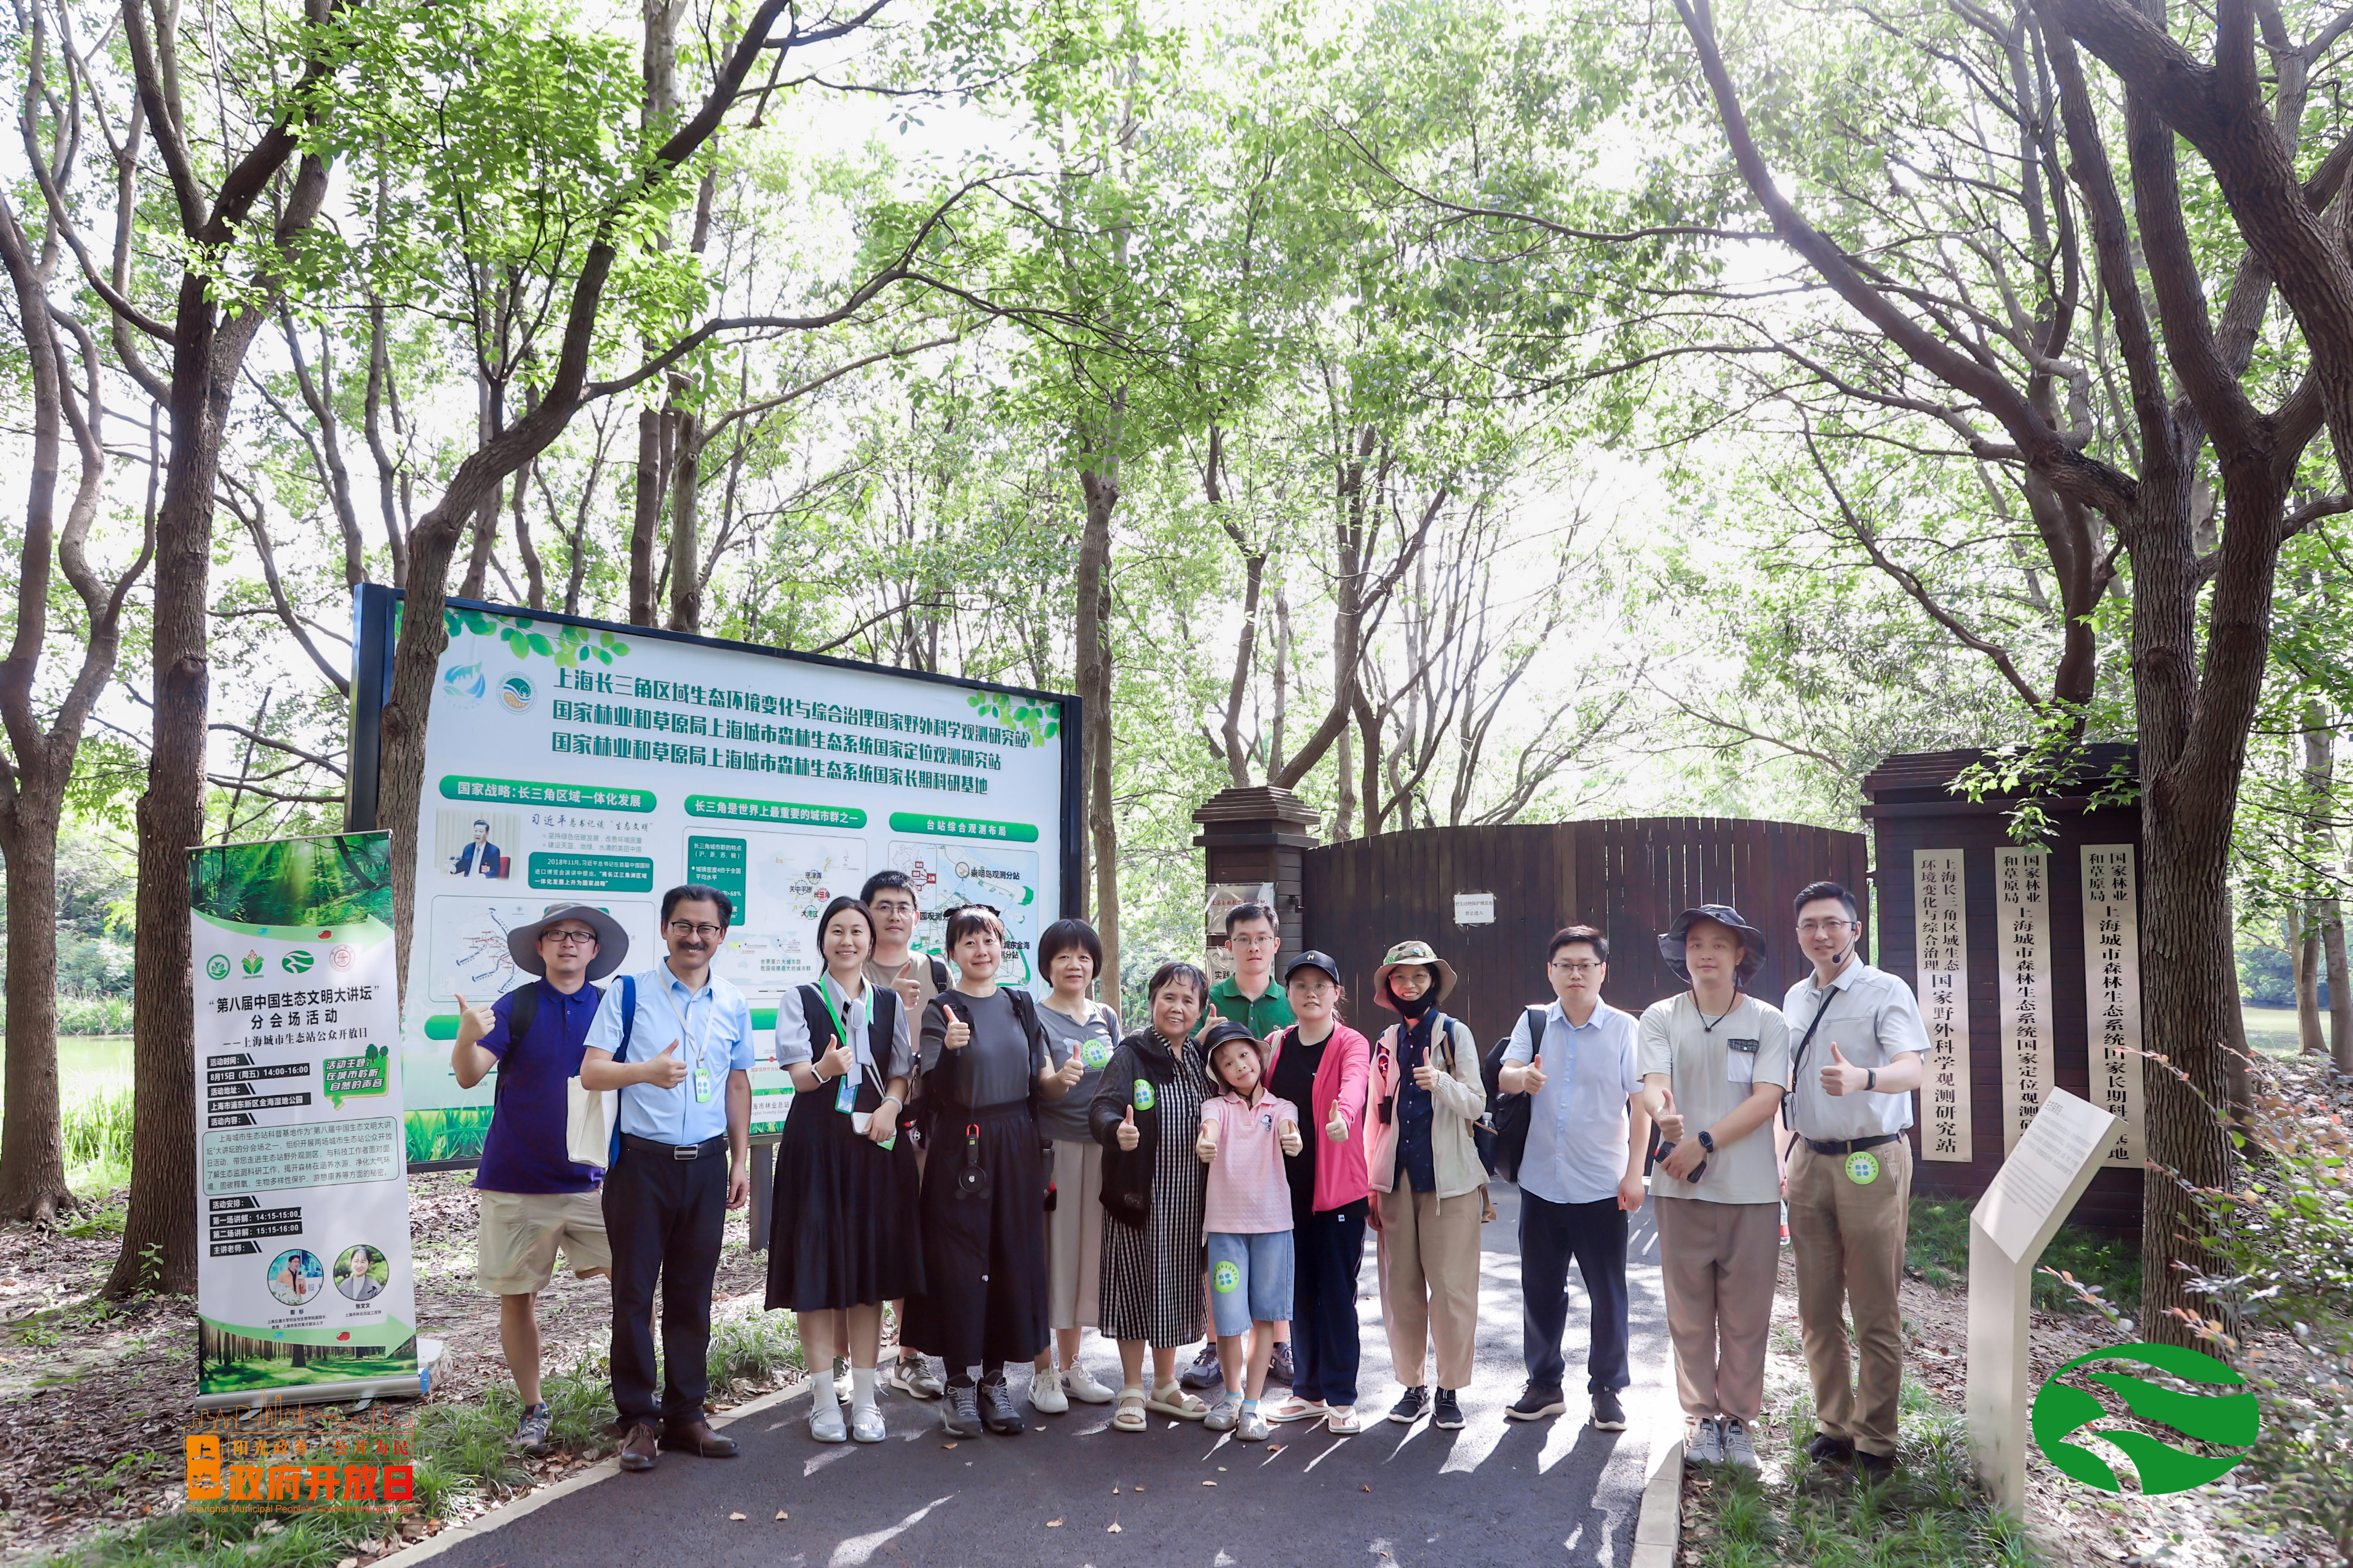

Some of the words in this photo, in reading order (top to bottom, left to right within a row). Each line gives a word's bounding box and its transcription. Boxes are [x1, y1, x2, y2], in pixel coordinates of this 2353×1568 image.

[554, 667, 1029, 748] 上海长三角区域生态环境变化与综合治理国家野外科学观测研究站
[553, 699, 1001, 770] 国家林业和草原局上海城市森林生态系统国家定位观测研究站
[552, 731, 988, 795] 国家林业和草原局上海城市森林生态系统国家长期科研基地
[695, 799, 859, 823] 长三角是世界上最重要的城市群之一
[926, 819, 1006, 837] 台站综合观测布局
[789, 885, 812, 893] 关中平原
[2003, 855, 2019, 904] 和草原局
[2024, 855, 2042, 903] 国家林业
[2088, 853, 2106, 902] 和草原局
[2110, 853, 2129, 902] 国家林业
[1921, 859, 1939, 970] 环境变化与综合治理
[1941, 859, 1959, 971] 上海长三角区域生态
[251, 1008, 338, 1030] 分会场活动
[2013, 906, 2039, 1136] 上海城市森林生态系统国家定位观测
[2098, 906, 2130, 1160] 上海城市森林生态系统国家长期科地
[325, 1068, 379, 1081] 在城市聆听
[329, 1078, 384, 1092] 自然的声音
[1931, 973, 1957, 1153] 国家野外科学观测研究站
[210, 1095, 304, 1111] 上海市浦东新区金海湿地公园
